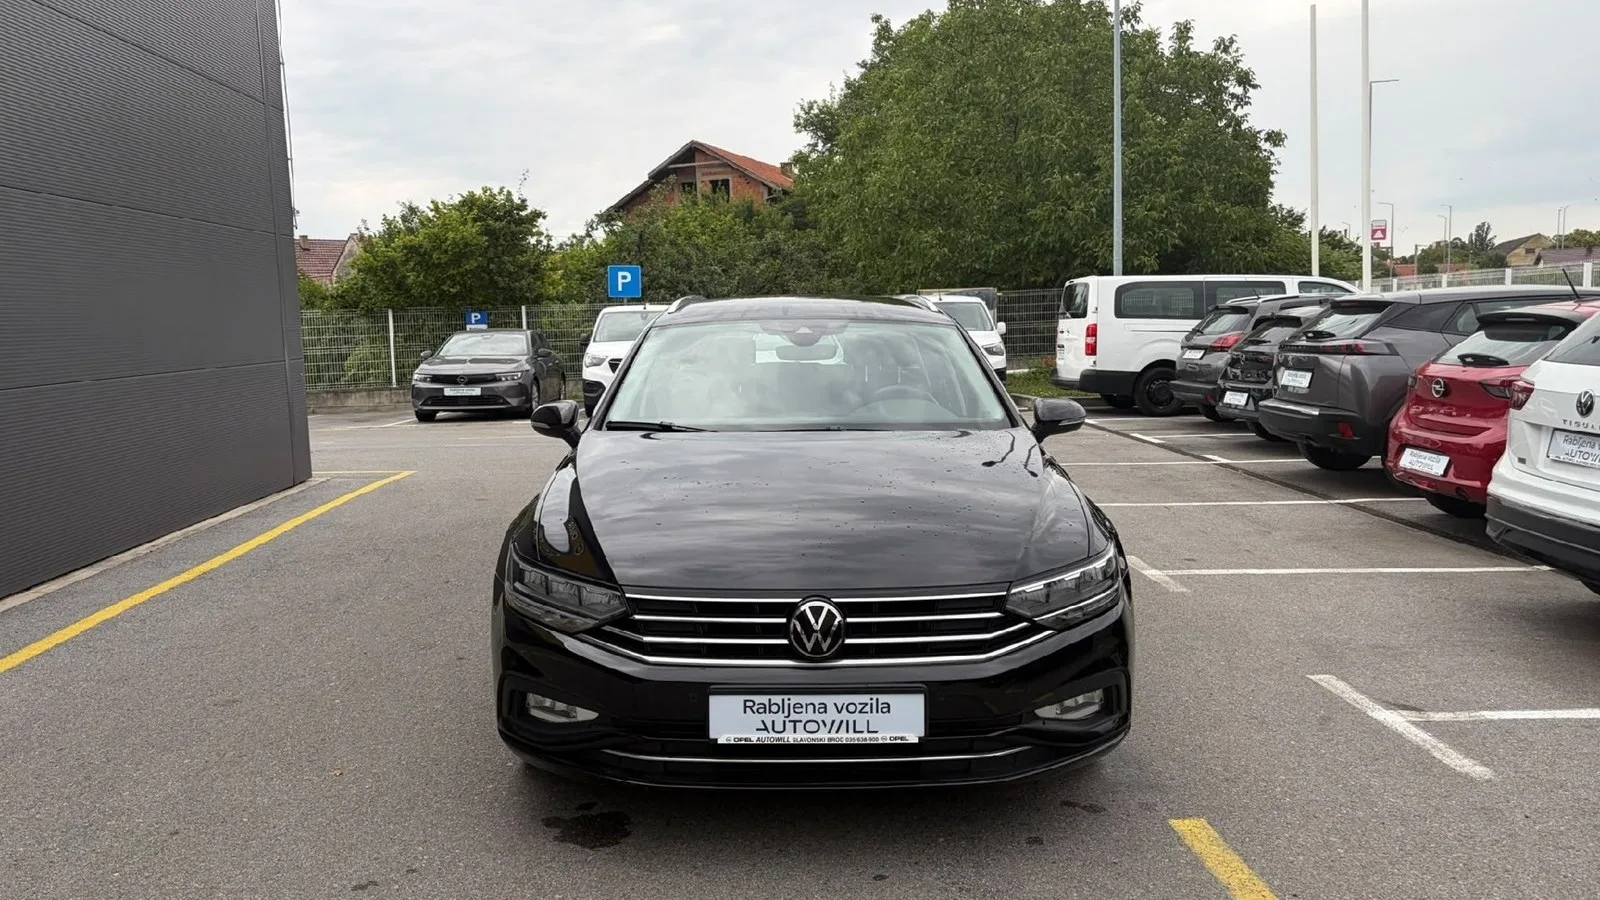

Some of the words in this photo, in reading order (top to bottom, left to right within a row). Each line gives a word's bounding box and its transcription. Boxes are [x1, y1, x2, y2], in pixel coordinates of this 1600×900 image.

[617, 271, 632, 292] P
[471, 312, 481, 324] P
[743, 697, 828, 719] Rabljena
[833, 697, 891, 714] vozila
[755, 719, 879, 734] AUTOWILL
